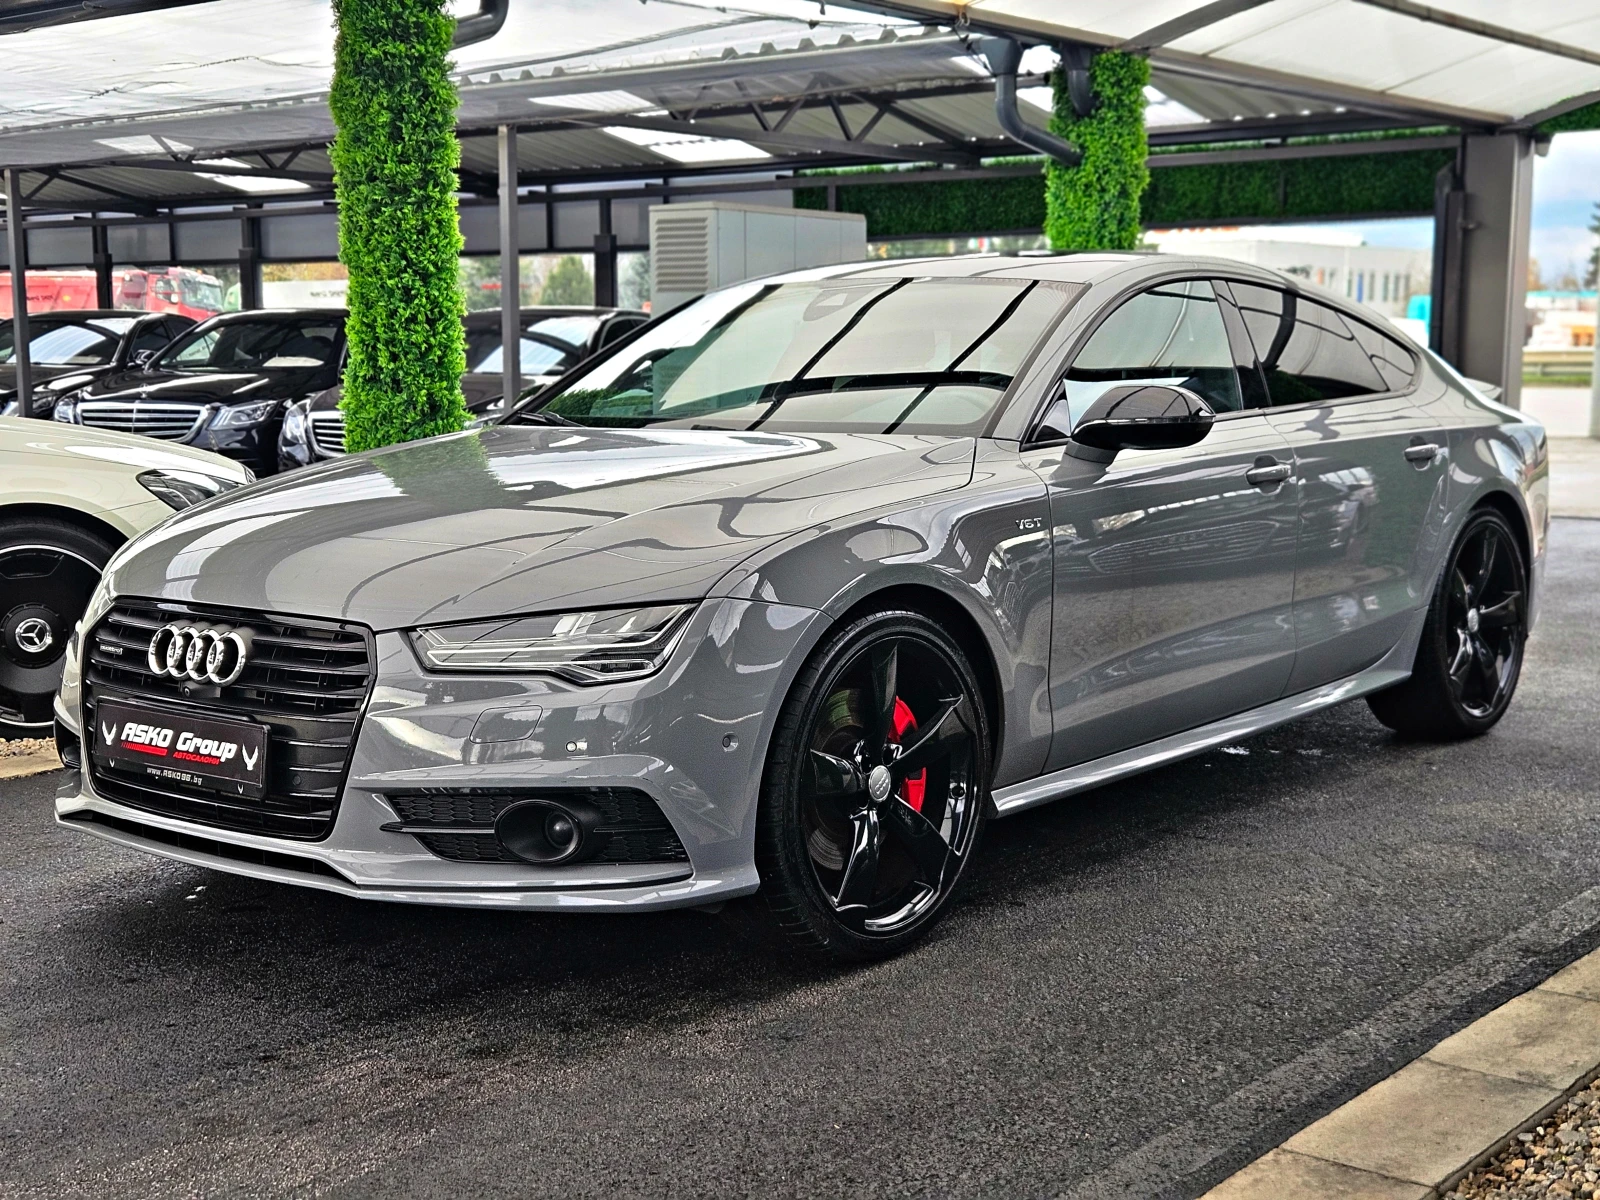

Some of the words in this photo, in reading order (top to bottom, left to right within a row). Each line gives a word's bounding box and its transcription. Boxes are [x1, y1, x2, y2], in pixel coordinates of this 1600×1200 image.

[1015, 517, 1042, 530] V6T
[120, 722, 174, 748] ASKO
[175, 731, 238, 763] Group
